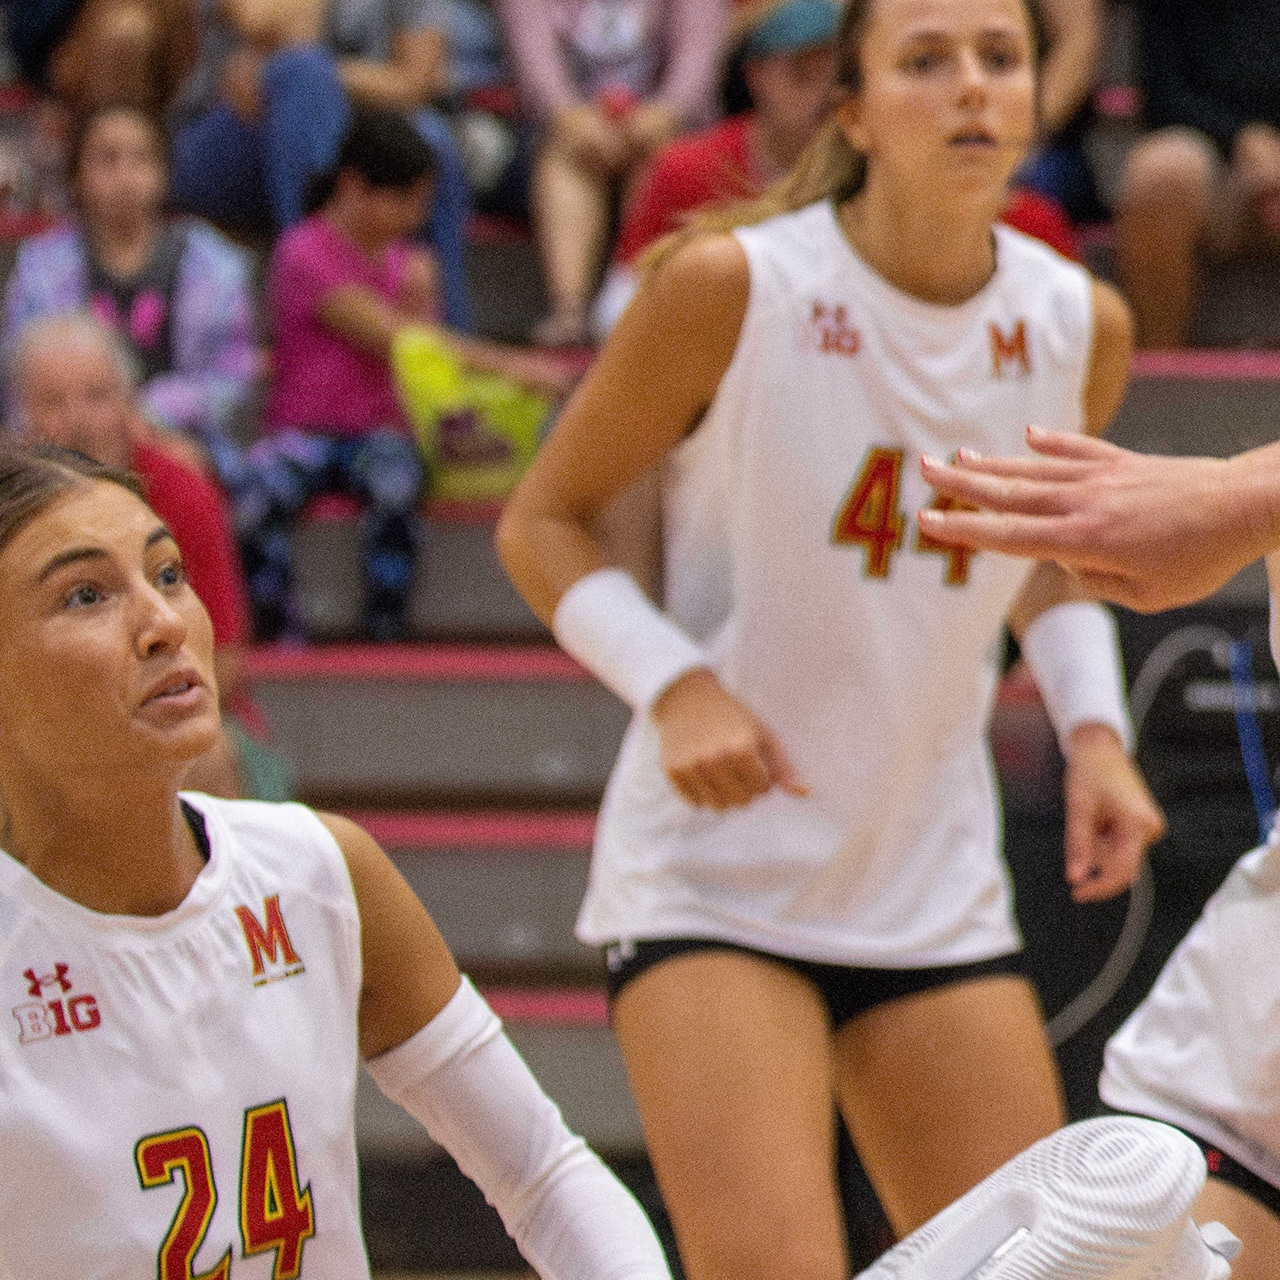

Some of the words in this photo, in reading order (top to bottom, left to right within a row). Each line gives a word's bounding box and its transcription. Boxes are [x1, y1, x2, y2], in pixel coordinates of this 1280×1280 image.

[987, 318, 1033, 379] M
[234, 894, 301, 977] M
[134, 1098, 317, 1280] 24
